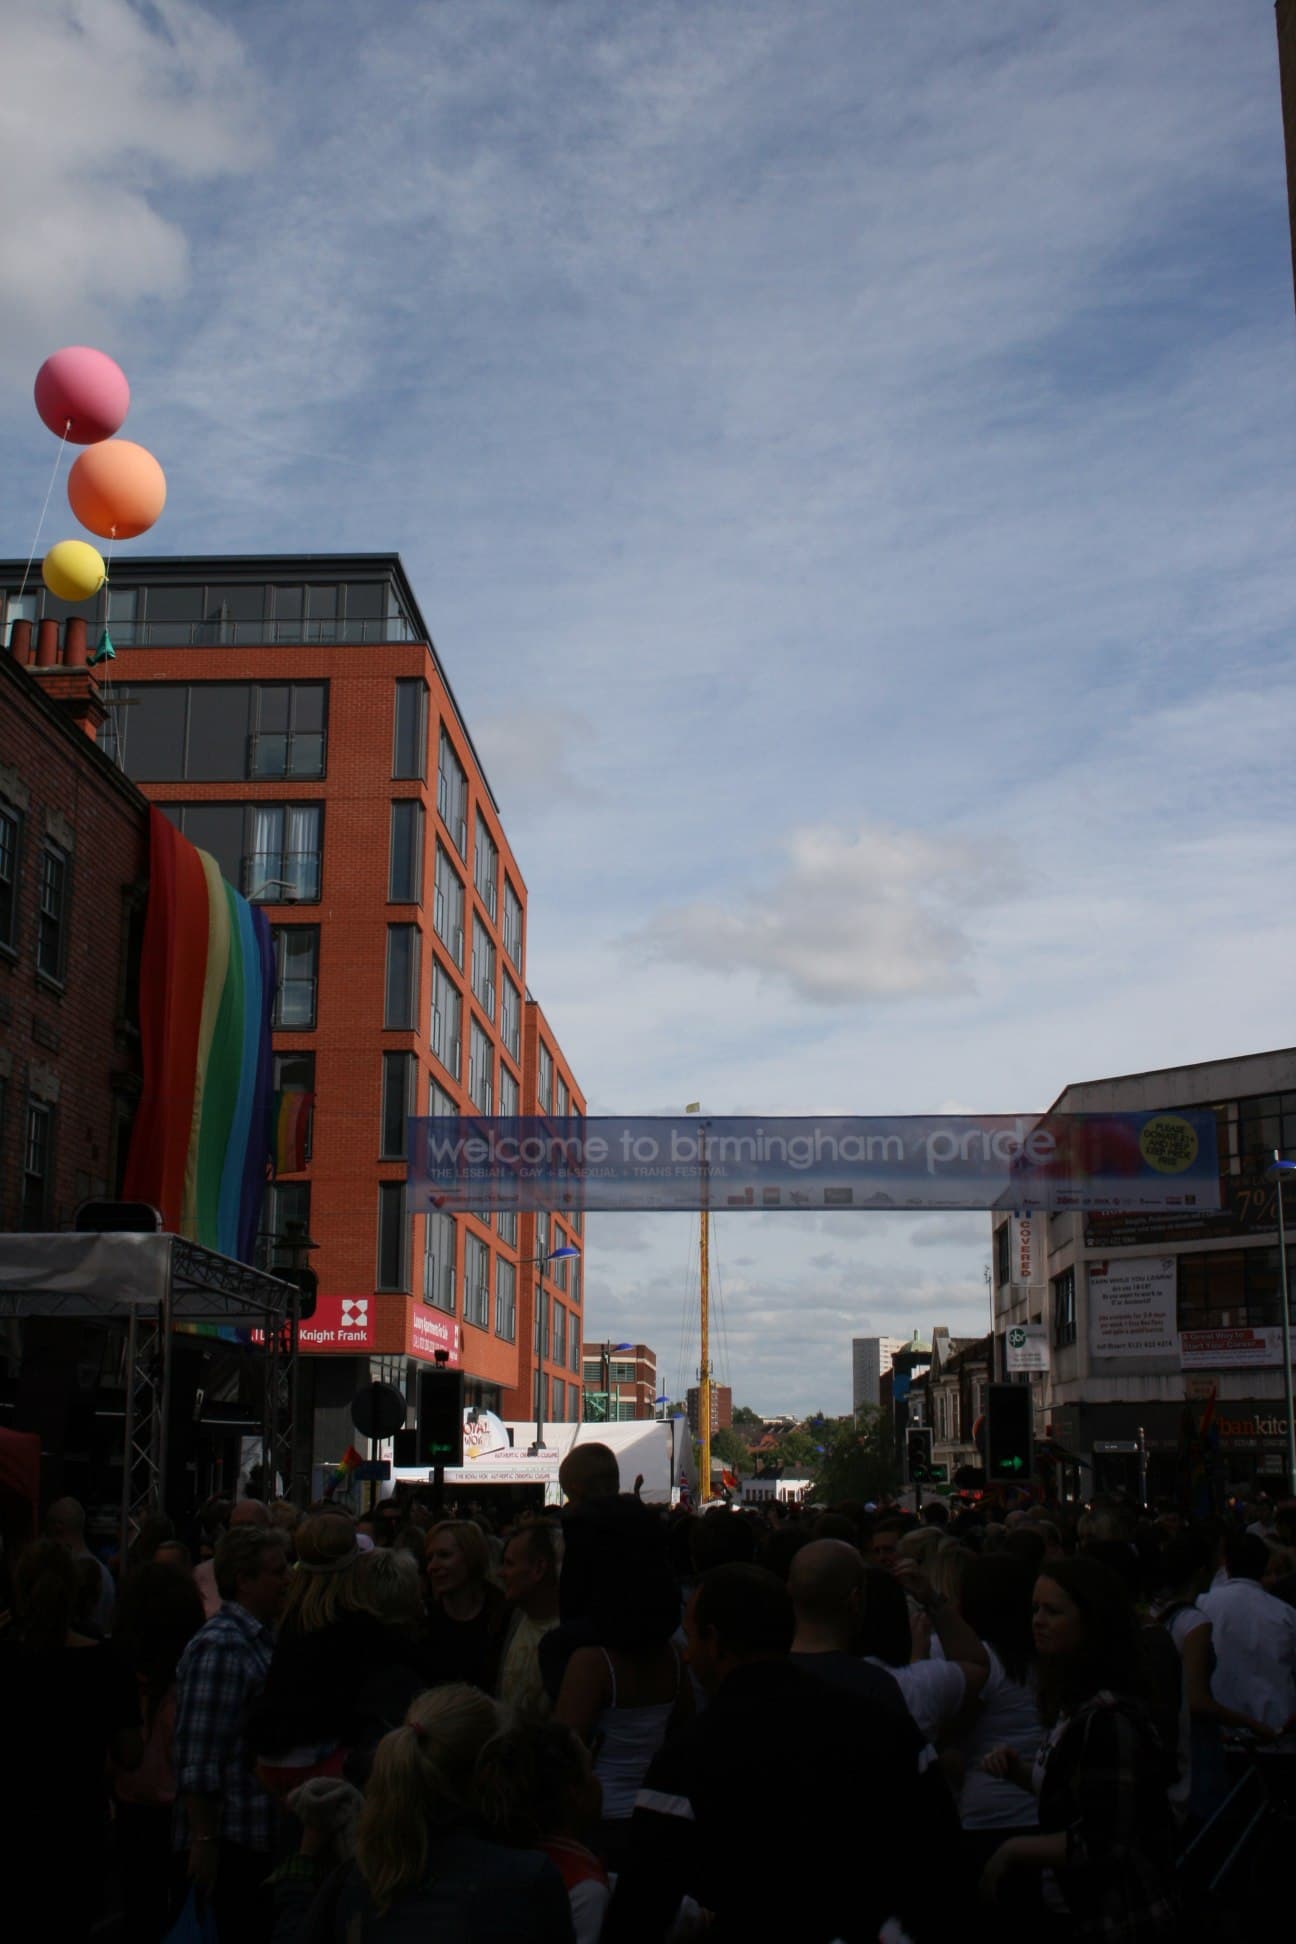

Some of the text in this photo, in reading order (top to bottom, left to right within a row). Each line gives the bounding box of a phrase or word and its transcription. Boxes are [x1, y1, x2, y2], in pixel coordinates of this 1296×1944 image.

[428, 1119, 1057, 1175] welcome to birmingham pride
[432, 1167, 452, 1178] THE
[456, 1167, 505, 1178] LESBIAN
[520, 1167, 543, 1177] GAY
[634, 1167, 672, 1177] TRANS
[675, 1167, 729, 1177] FESTIVAL
[1020, 1220, 1031, 1278] COVERED
[299, 1329, 367, 1343] Knight Frank
[462, 1422, 490, 1435] OYAL
